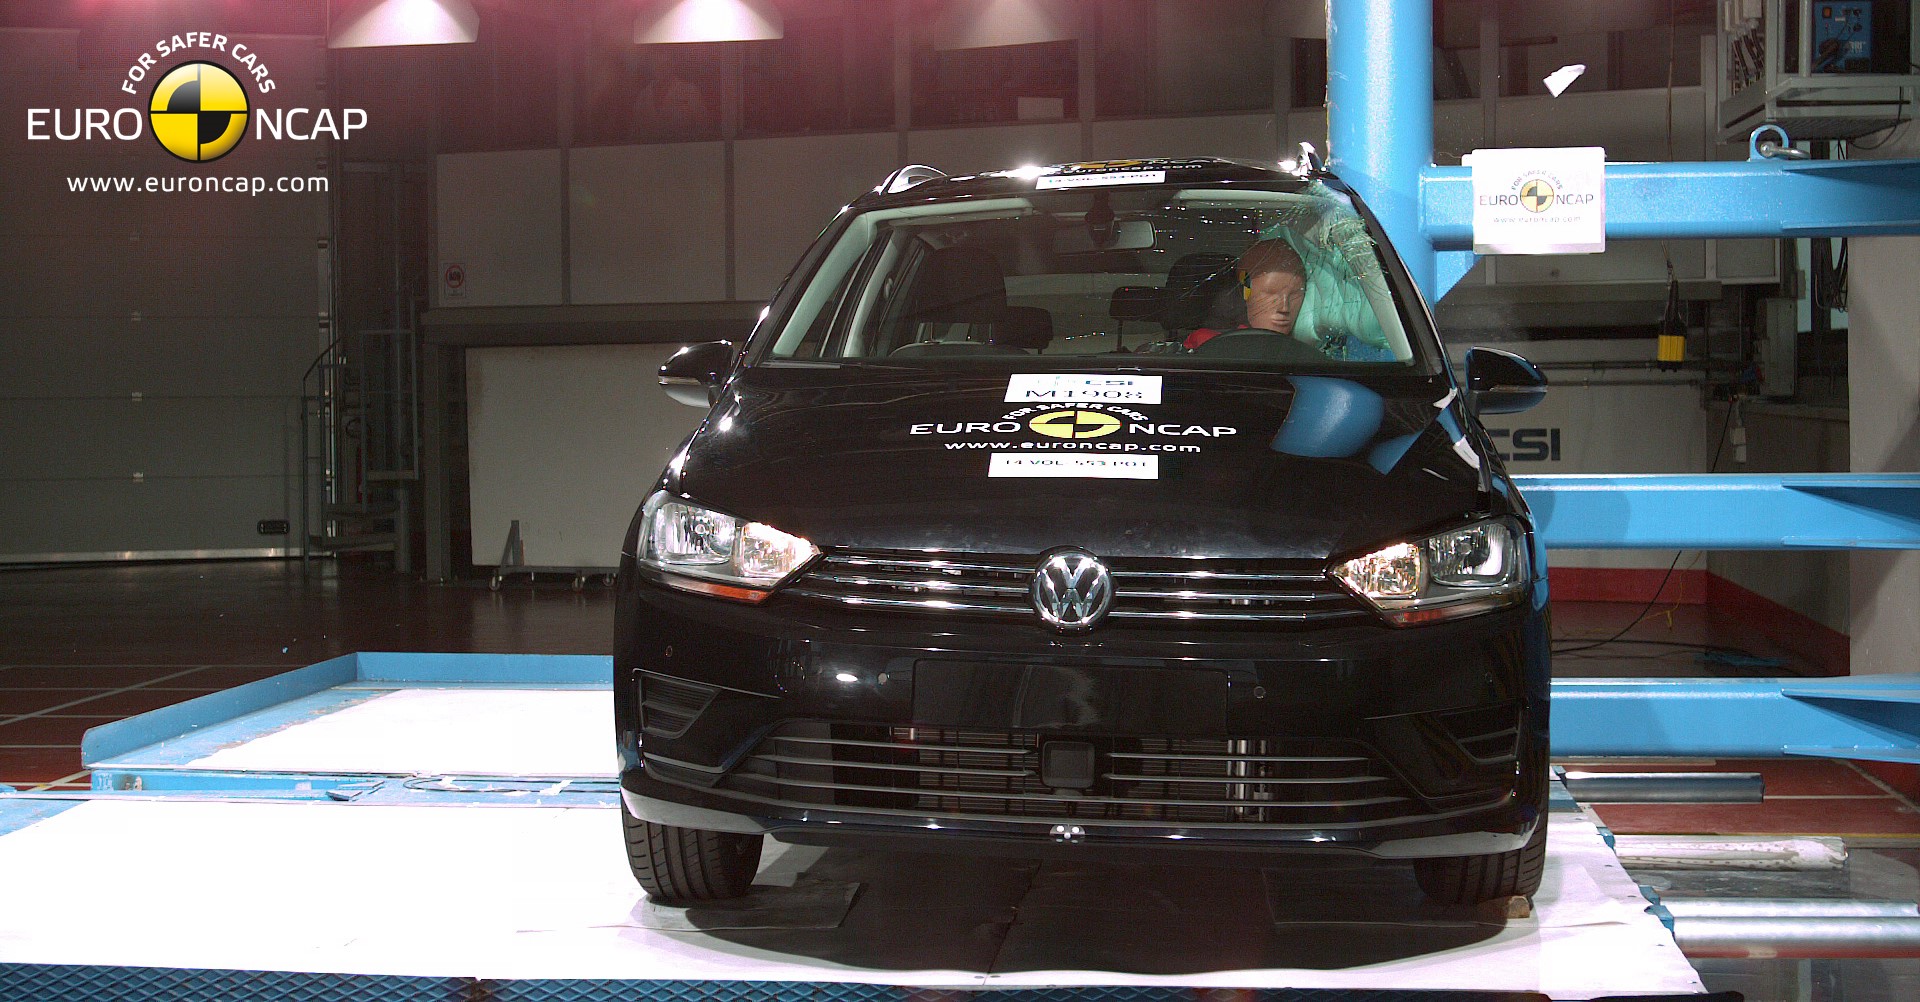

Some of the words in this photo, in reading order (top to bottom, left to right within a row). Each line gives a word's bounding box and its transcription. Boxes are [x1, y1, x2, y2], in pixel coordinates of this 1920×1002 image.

[1479, 194, 1519, 206] EURO
[1555, 193, 1594, 206] NCAP
[1002, 407, 1037, 420] FOR
[1035, 402, 1104, 411] SAFER
[1106, 404, 1149, 421] CARS
[909, 421, 1021, 435] EURO
[1129, 423, 1237, 438] NCAP
[944, 441, 1201, 453] www.euroncap.com
